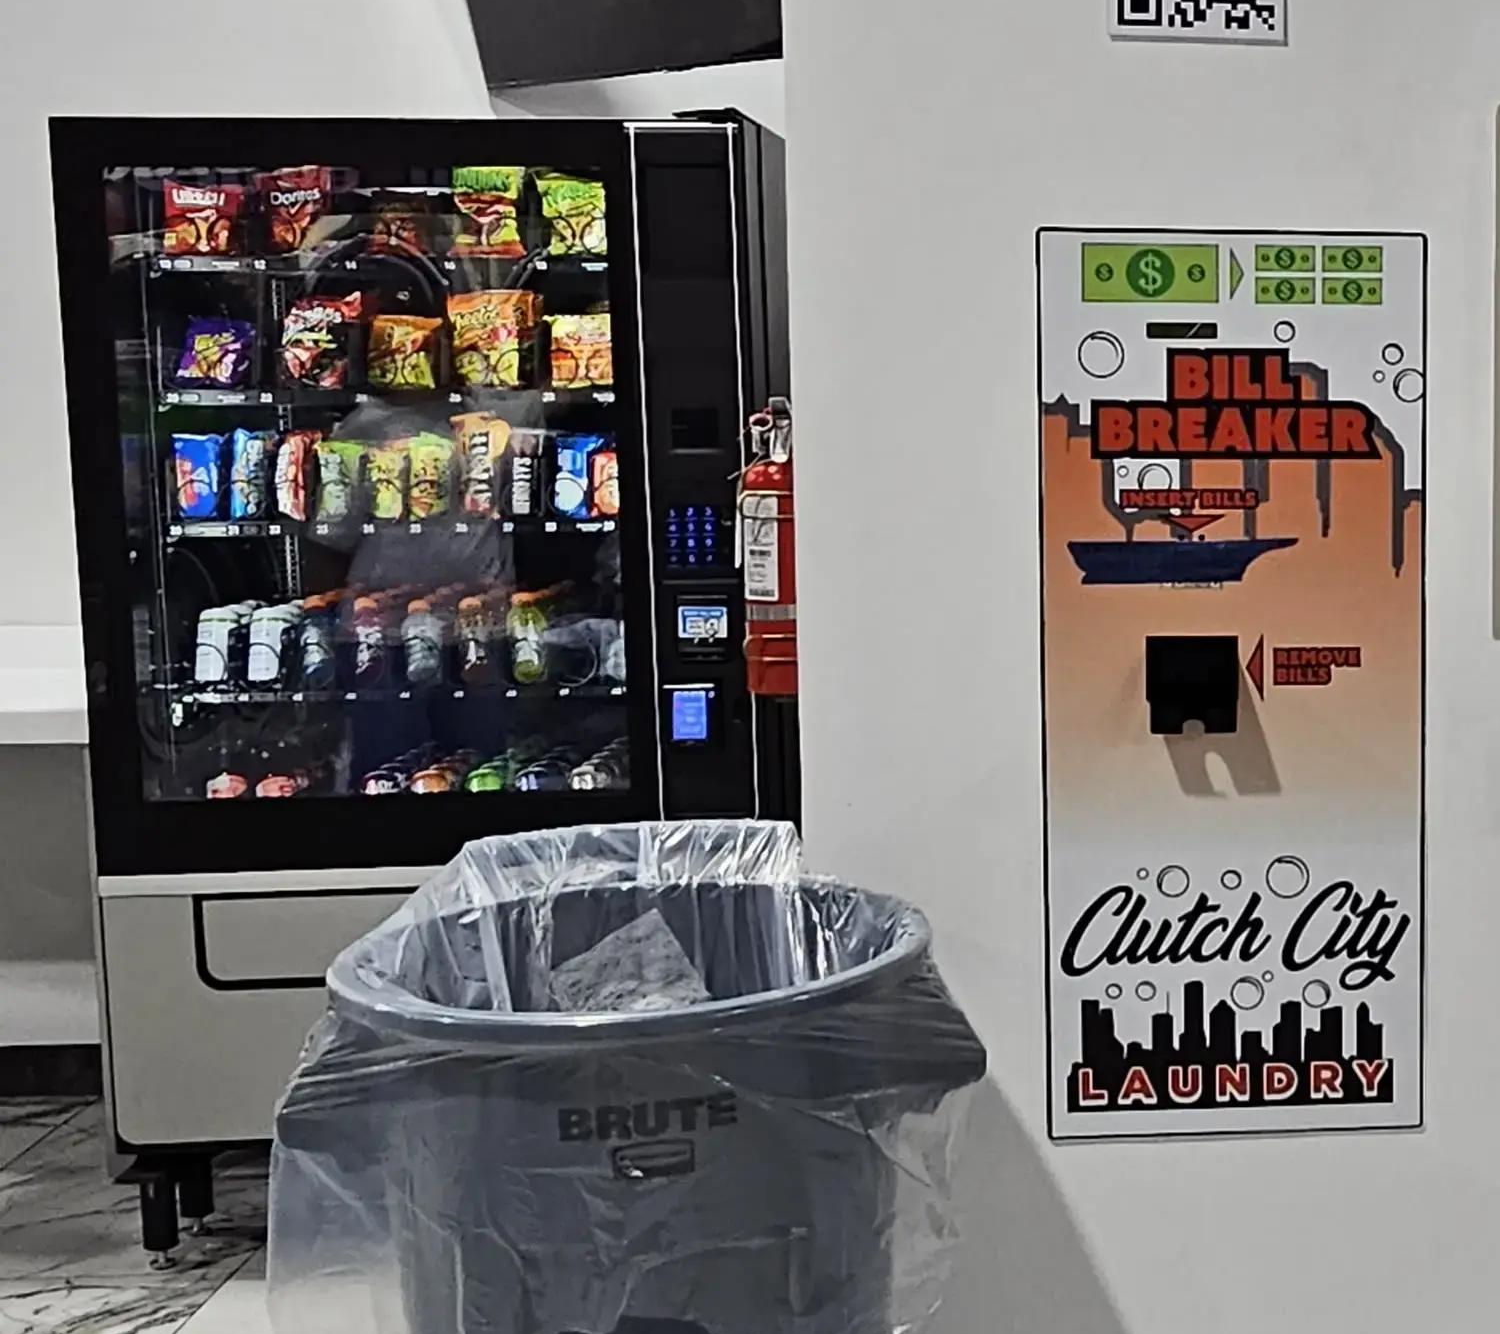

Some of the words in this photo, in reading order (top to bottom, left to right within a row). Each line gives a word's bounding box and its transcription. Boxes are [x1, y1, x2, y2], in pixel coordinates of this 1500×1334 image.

[270, 187, 321, 206] Doritos
[1173, 354, 1294, 400] BILL
[1098, 407, 1371, 453] BREAKER
[1121, 491, 1195, 507] INSERT
[1202, 492, 1257, 507] BILLS
[1275, 650, 1360, 666] REMOVE
[1275, 668, 1331, 684] BILLS
[1060, 883, 1272, 978] Clutch
[1281, 880, 1411, 991] City
[1078, 1058, 1389, 1106] LAUNDRY
[556, 1090, 738, 1142] BRUTE
